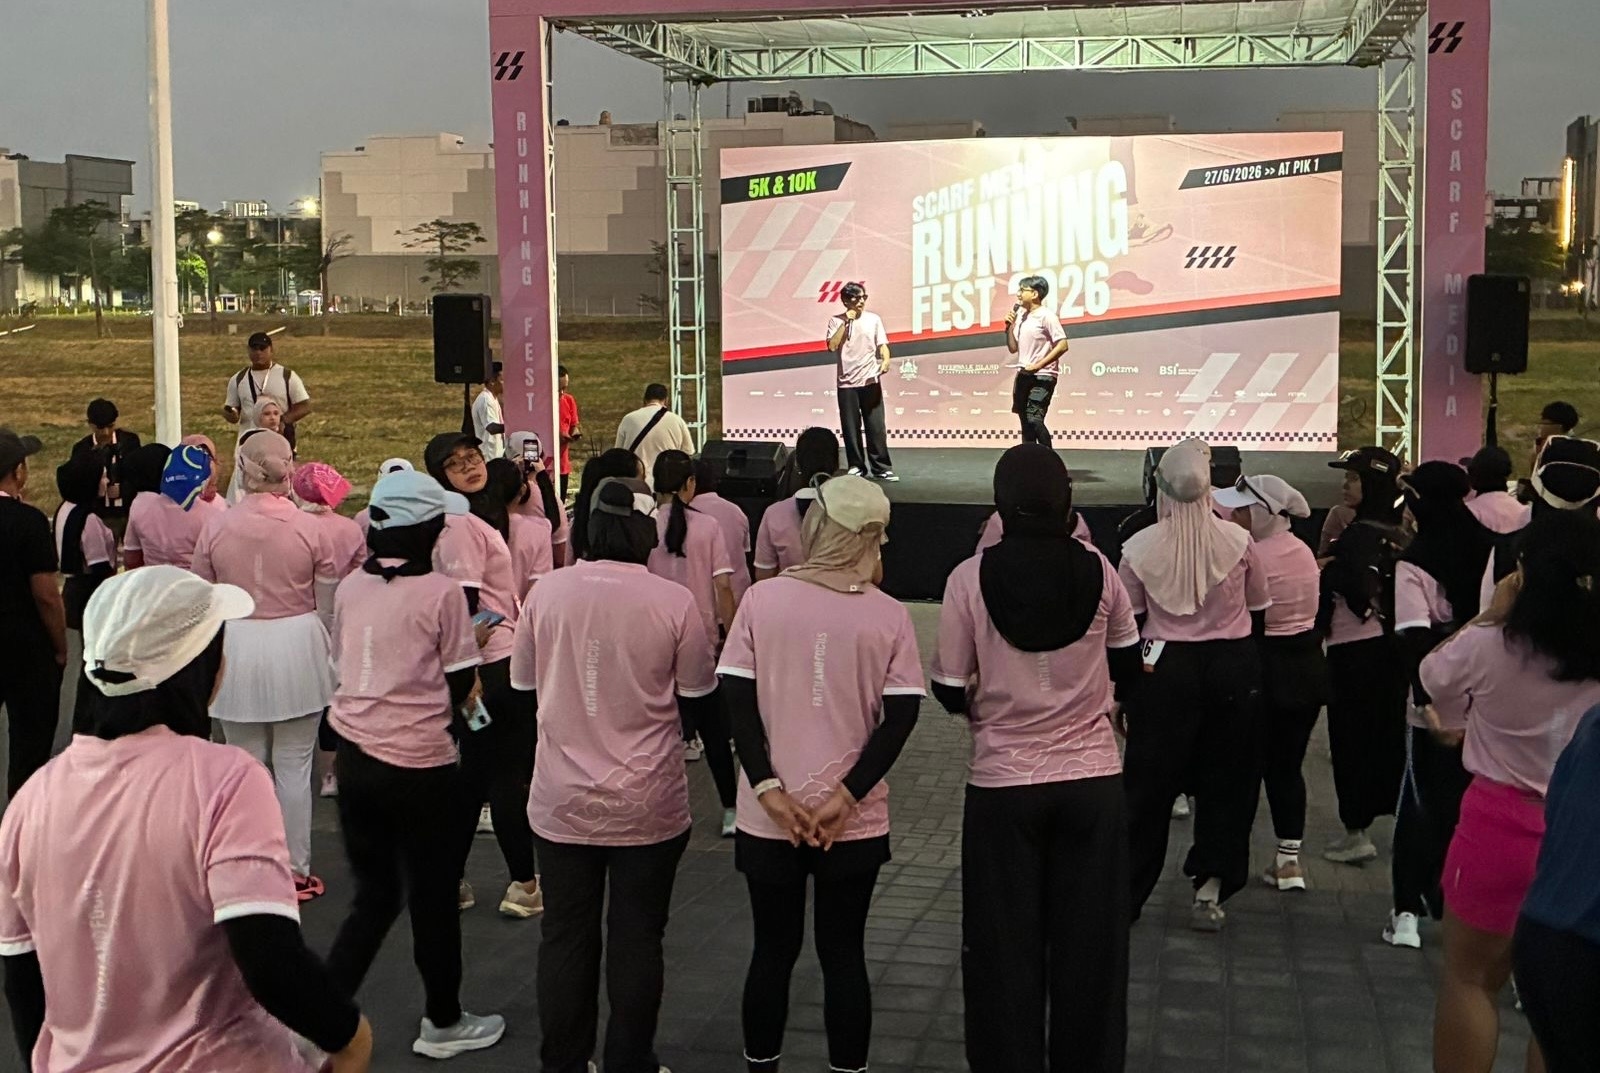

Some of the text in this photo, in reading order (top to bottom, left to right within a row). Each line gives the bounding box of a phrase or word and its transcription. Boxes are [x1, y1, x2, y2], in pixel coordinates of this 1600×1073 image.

[748, 170, 817, 198] 5K & 10K
[1204, 158, 1319, 185] 27/6/2026 AT PIK 1
[912, 178, 974, 222] SCARF
[912, 160, 1129, 287] RUNNING
[516, 111, 534, 412] RUNNING FEST
[1445, 88, 1463, 416] SCARF MEDIA
[912, 276, 996, 334] FEST
[1106, 364, 1139, 374] netzme
[1159, 364, 1179, 376] BSI
